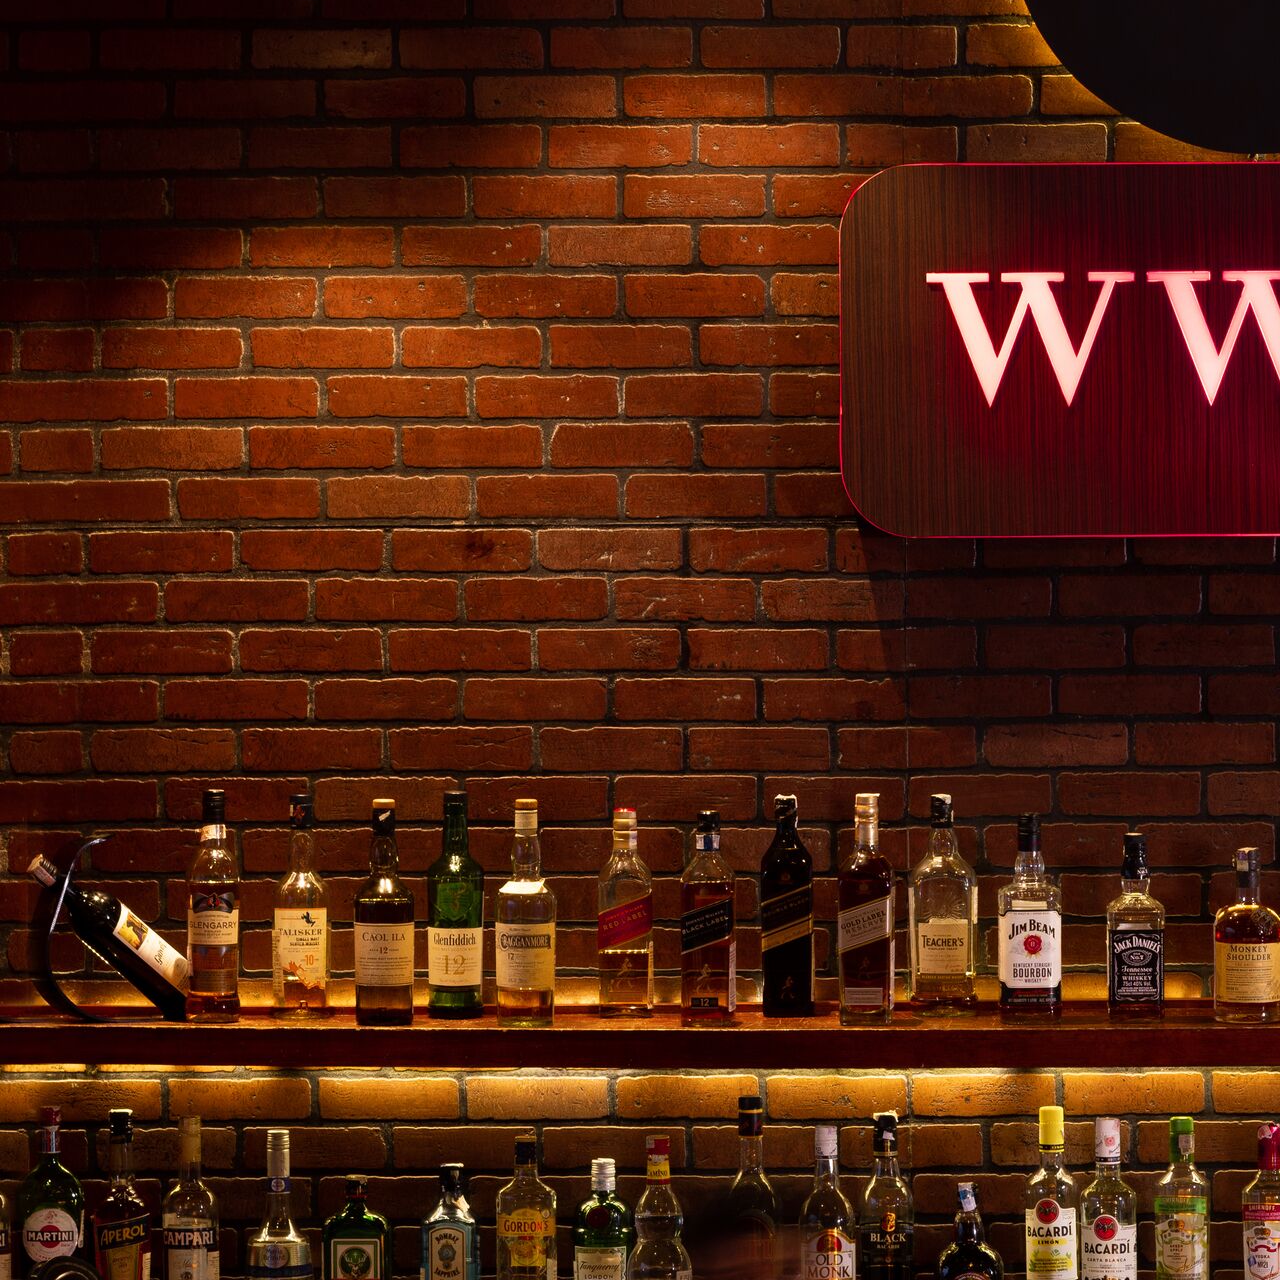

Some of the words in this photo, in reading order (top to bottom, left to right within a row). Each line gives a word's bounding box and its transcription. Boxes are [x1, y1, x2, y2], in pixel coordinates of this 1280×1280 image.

[602, 920, 620, 931] RED
[620, 910, 648, 924] LABEL
[681, 923, 705, 936] BLACK
[705, 914, 729, 927] LABEL
[840, 918, 861, 930] GOLD
[862, 910, 887, 923] LABEL
[278, 927, 323, 937] TALISKER
[1008, 922, 1027, 940] JIM
[1028, 918, 1056, 939] BEAM
[362, 931, 389, 942] CAOL
[391, 932, 406, 942] ILA
[433, 932, 476, 946] Glenfiddich
[920, 934, 965, 949] TEACHER'S
[379, 946, 389, 954] 12
[1113, 939, 1133, 954] JACK
[1132, 935, 1161, 953] DANIEL'S
[1229, 944, 1268, 953] MONKEY
[304, 954, 314, 966] 10
[507, 953, 515, 961] 12
[1226, 952, 1272, 961] SHOULDER
[442, 954, 466, 976] 12
[1121, 965, 1153, 973] Tennessee
[1012, 967, 1052, 979] BOURBON
[700, 998, 710, 1008] 12
[503, 1219, 549, 1232] GORDON'S
[1027, 1222, 1073, 1237] BACARDÍ
[26, 1231, 74, 1241] MARTINI
[100, 1223, 146, 1248] APEROL
[162, 1228, 215, 1246] CAMPARI
[435, 1231, 460, 1245] BOMBAY
[870, 1232, 907, 1243] BLACK
[1084, 1240, 1130, 1255] BACARDÍ
[579, 1260, 620, 1272] Tanqueray
[815, 1253, 843, 1266] OLD
[433, 1267, 461, 1279] SAPPHIRE
[807, 1265, 850, 1278] MONK
